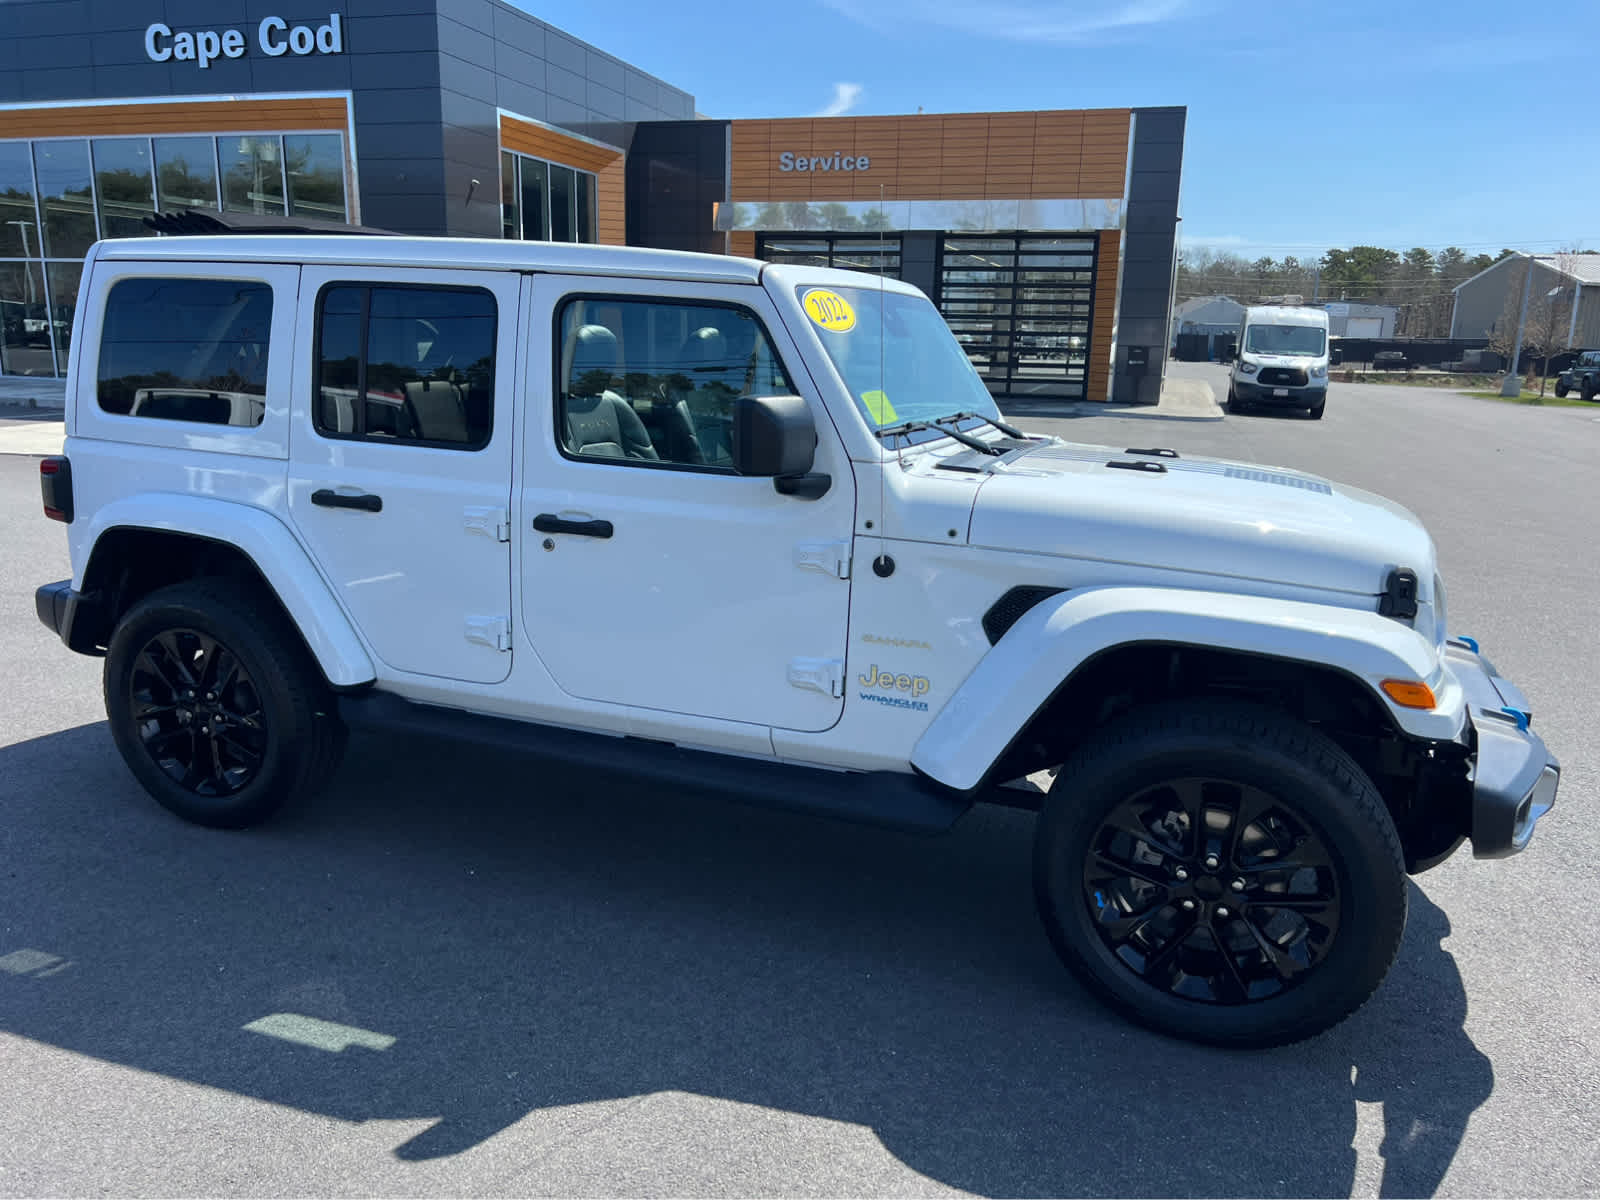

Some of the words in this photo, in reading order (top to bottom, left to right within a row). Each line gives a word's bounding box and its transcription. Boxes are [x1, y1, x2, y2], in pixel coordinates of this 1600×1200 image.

[145, 23, 245, 68] Cape
[258, 13, 343, 56] Cod
[779, 151, 870, 172] Service
[811, 296, 848, 323] 2022
[858, 664, 929, 697] Jeep
[860, 692, 929, 710] WRANGLER
